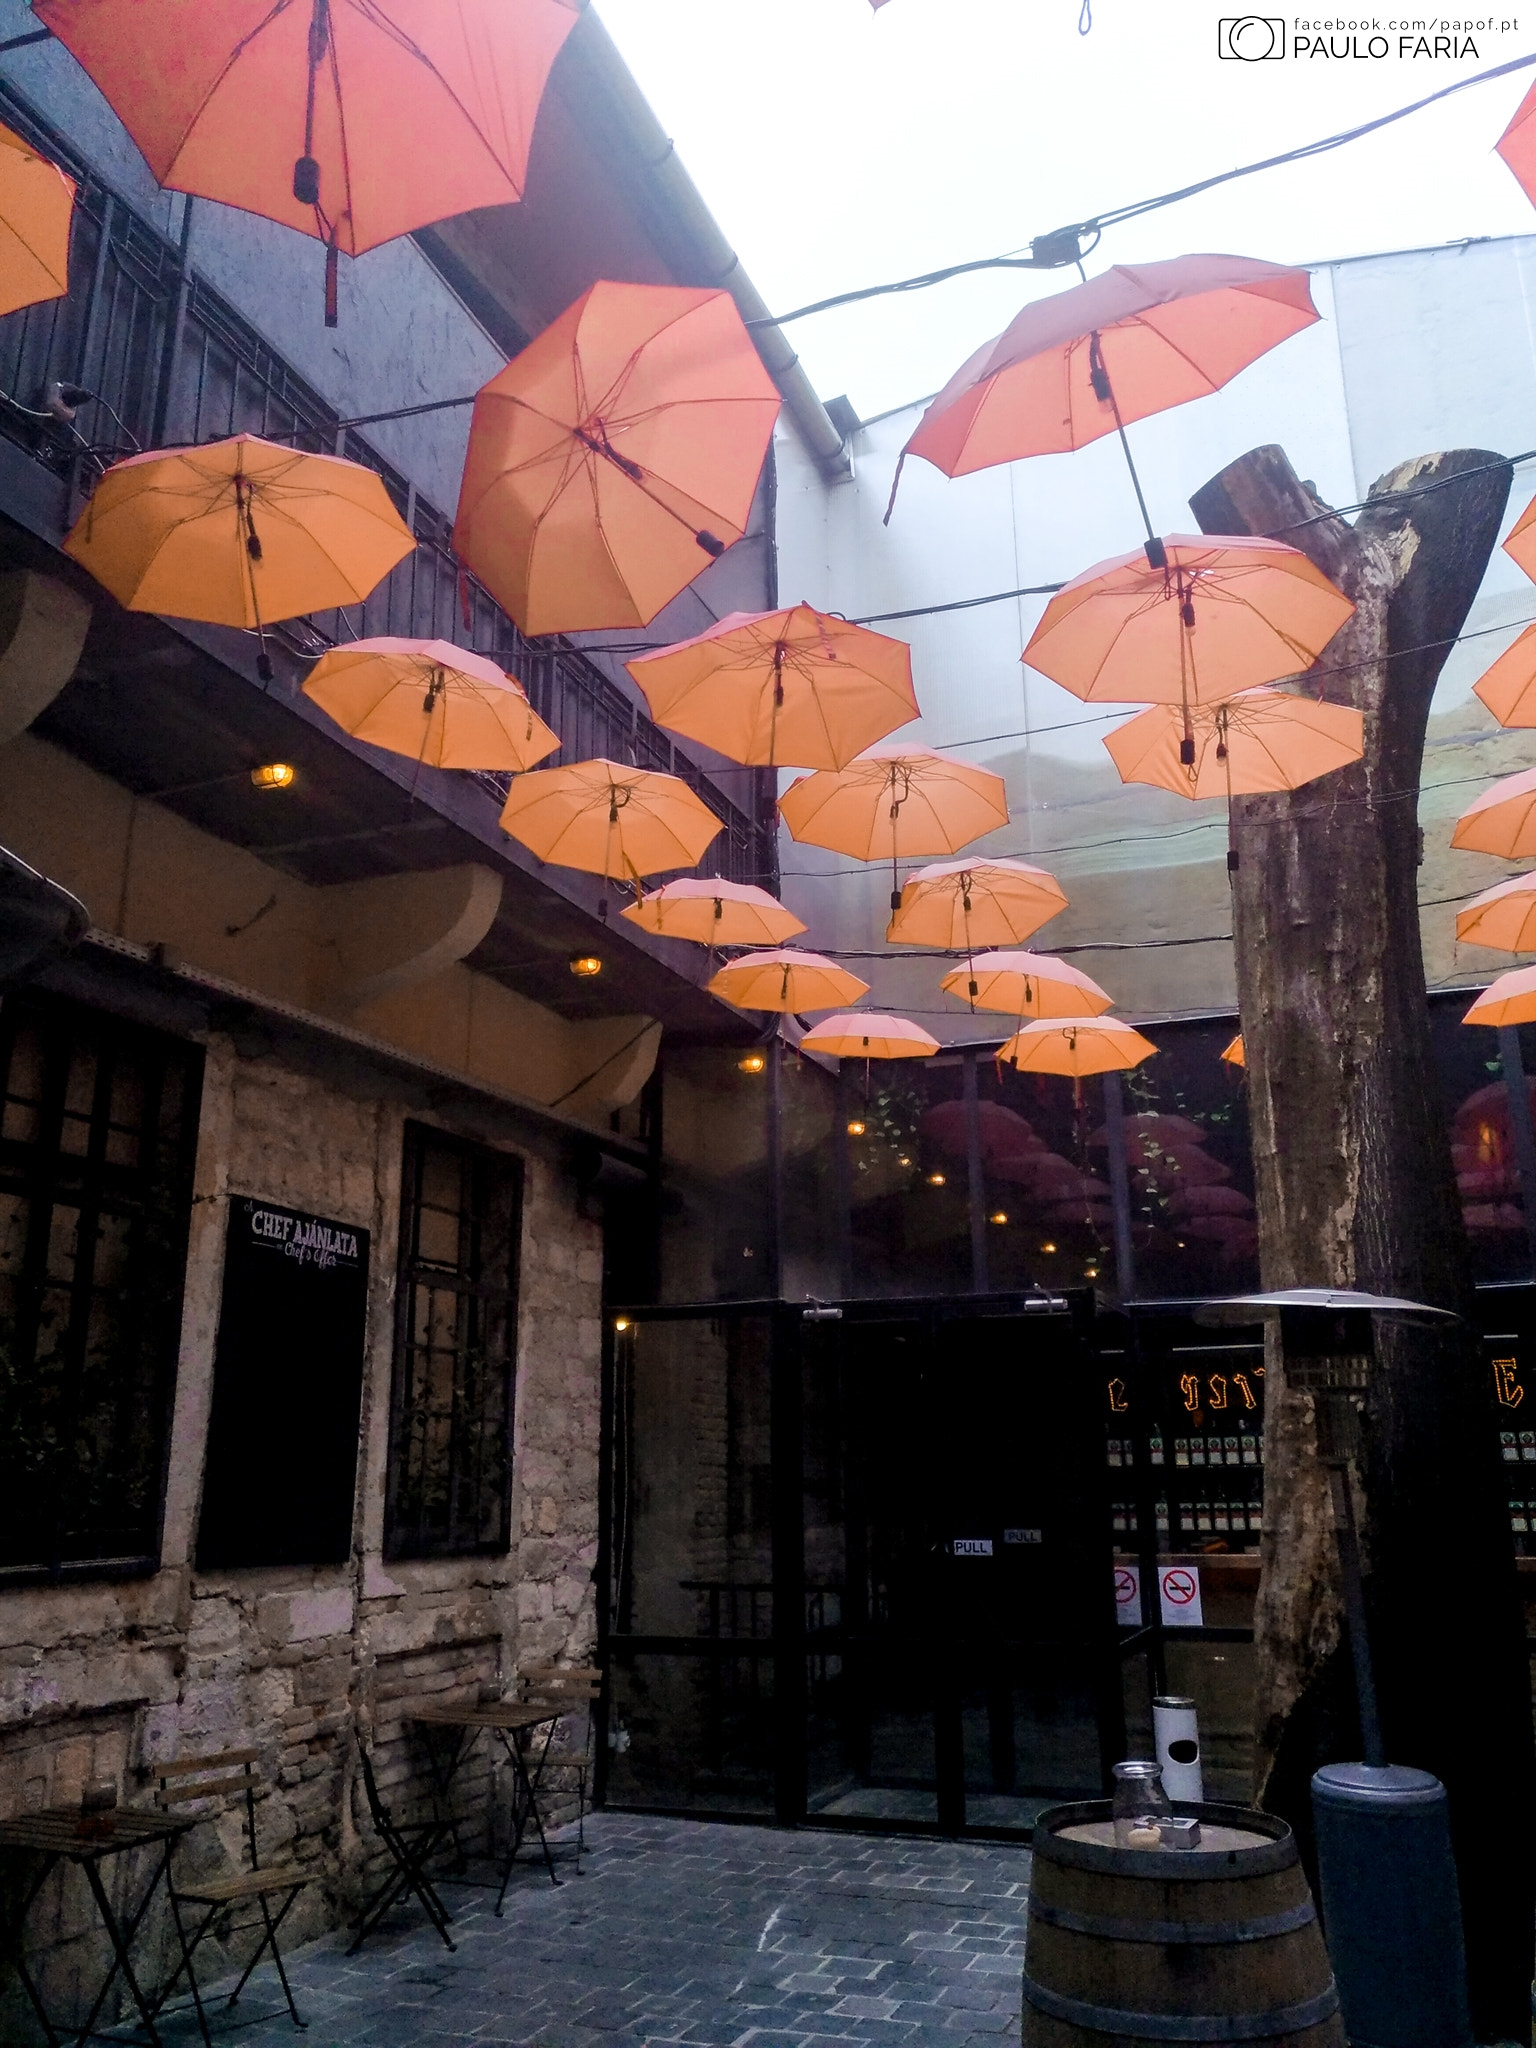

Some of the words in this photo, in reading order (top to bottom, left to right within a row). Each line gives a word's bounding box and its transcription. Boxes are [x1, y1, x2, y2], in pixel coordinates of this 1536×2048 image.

[251, 1210, 293, 1240] CHEF
[293, 1219, 358, 1258] AJÁNLATA
[1008, 1531, 1038, 1542] PULL
[955, 1542, 988, 1553] PULL
